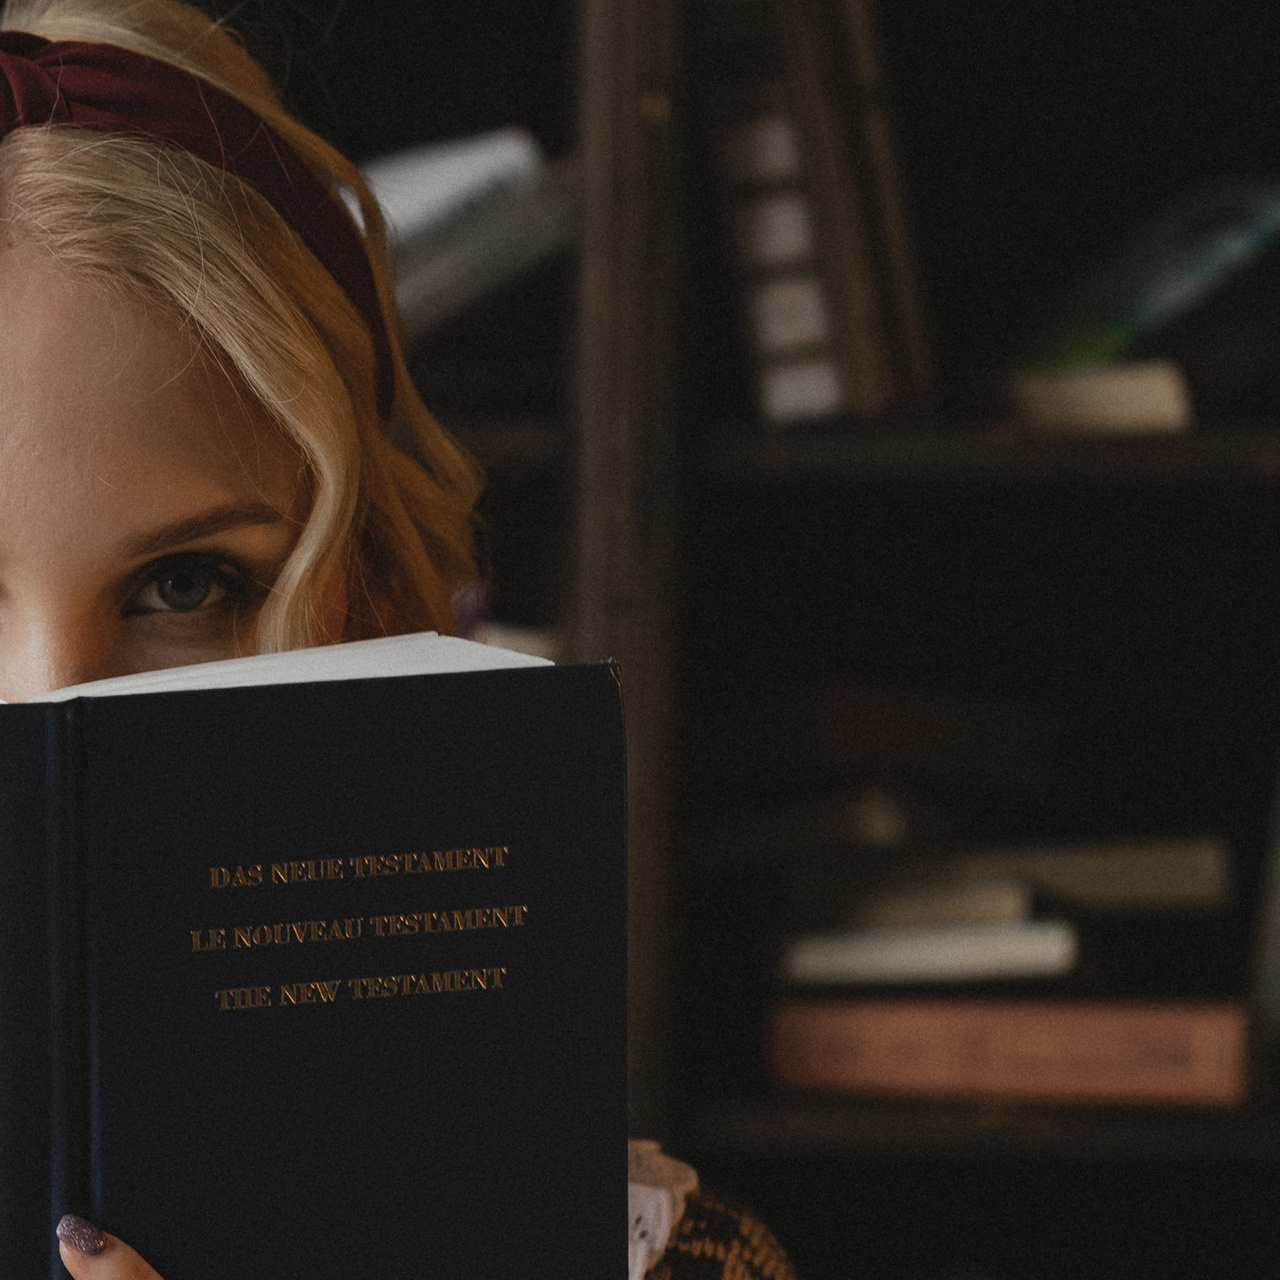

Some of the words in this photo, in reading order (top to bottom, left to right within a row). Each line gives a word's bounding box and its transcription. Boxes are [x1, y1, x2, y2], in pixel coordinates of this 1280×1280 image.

[210, 865, 262, 888] DAS
[271, 859, 344, 884] NEUE
[350, 846, 509, 878] TESTAMENT
[190, 929, 226, 952] LE
[233, 918, 363, 948] NOUVEAU
[370, 905, 528, 937] TESTAMENT
[215, 986, 271, 1010] THE
[280, 980, 341, 1006] NEW
[348, 967, 506, 1000] TESTAMENT
